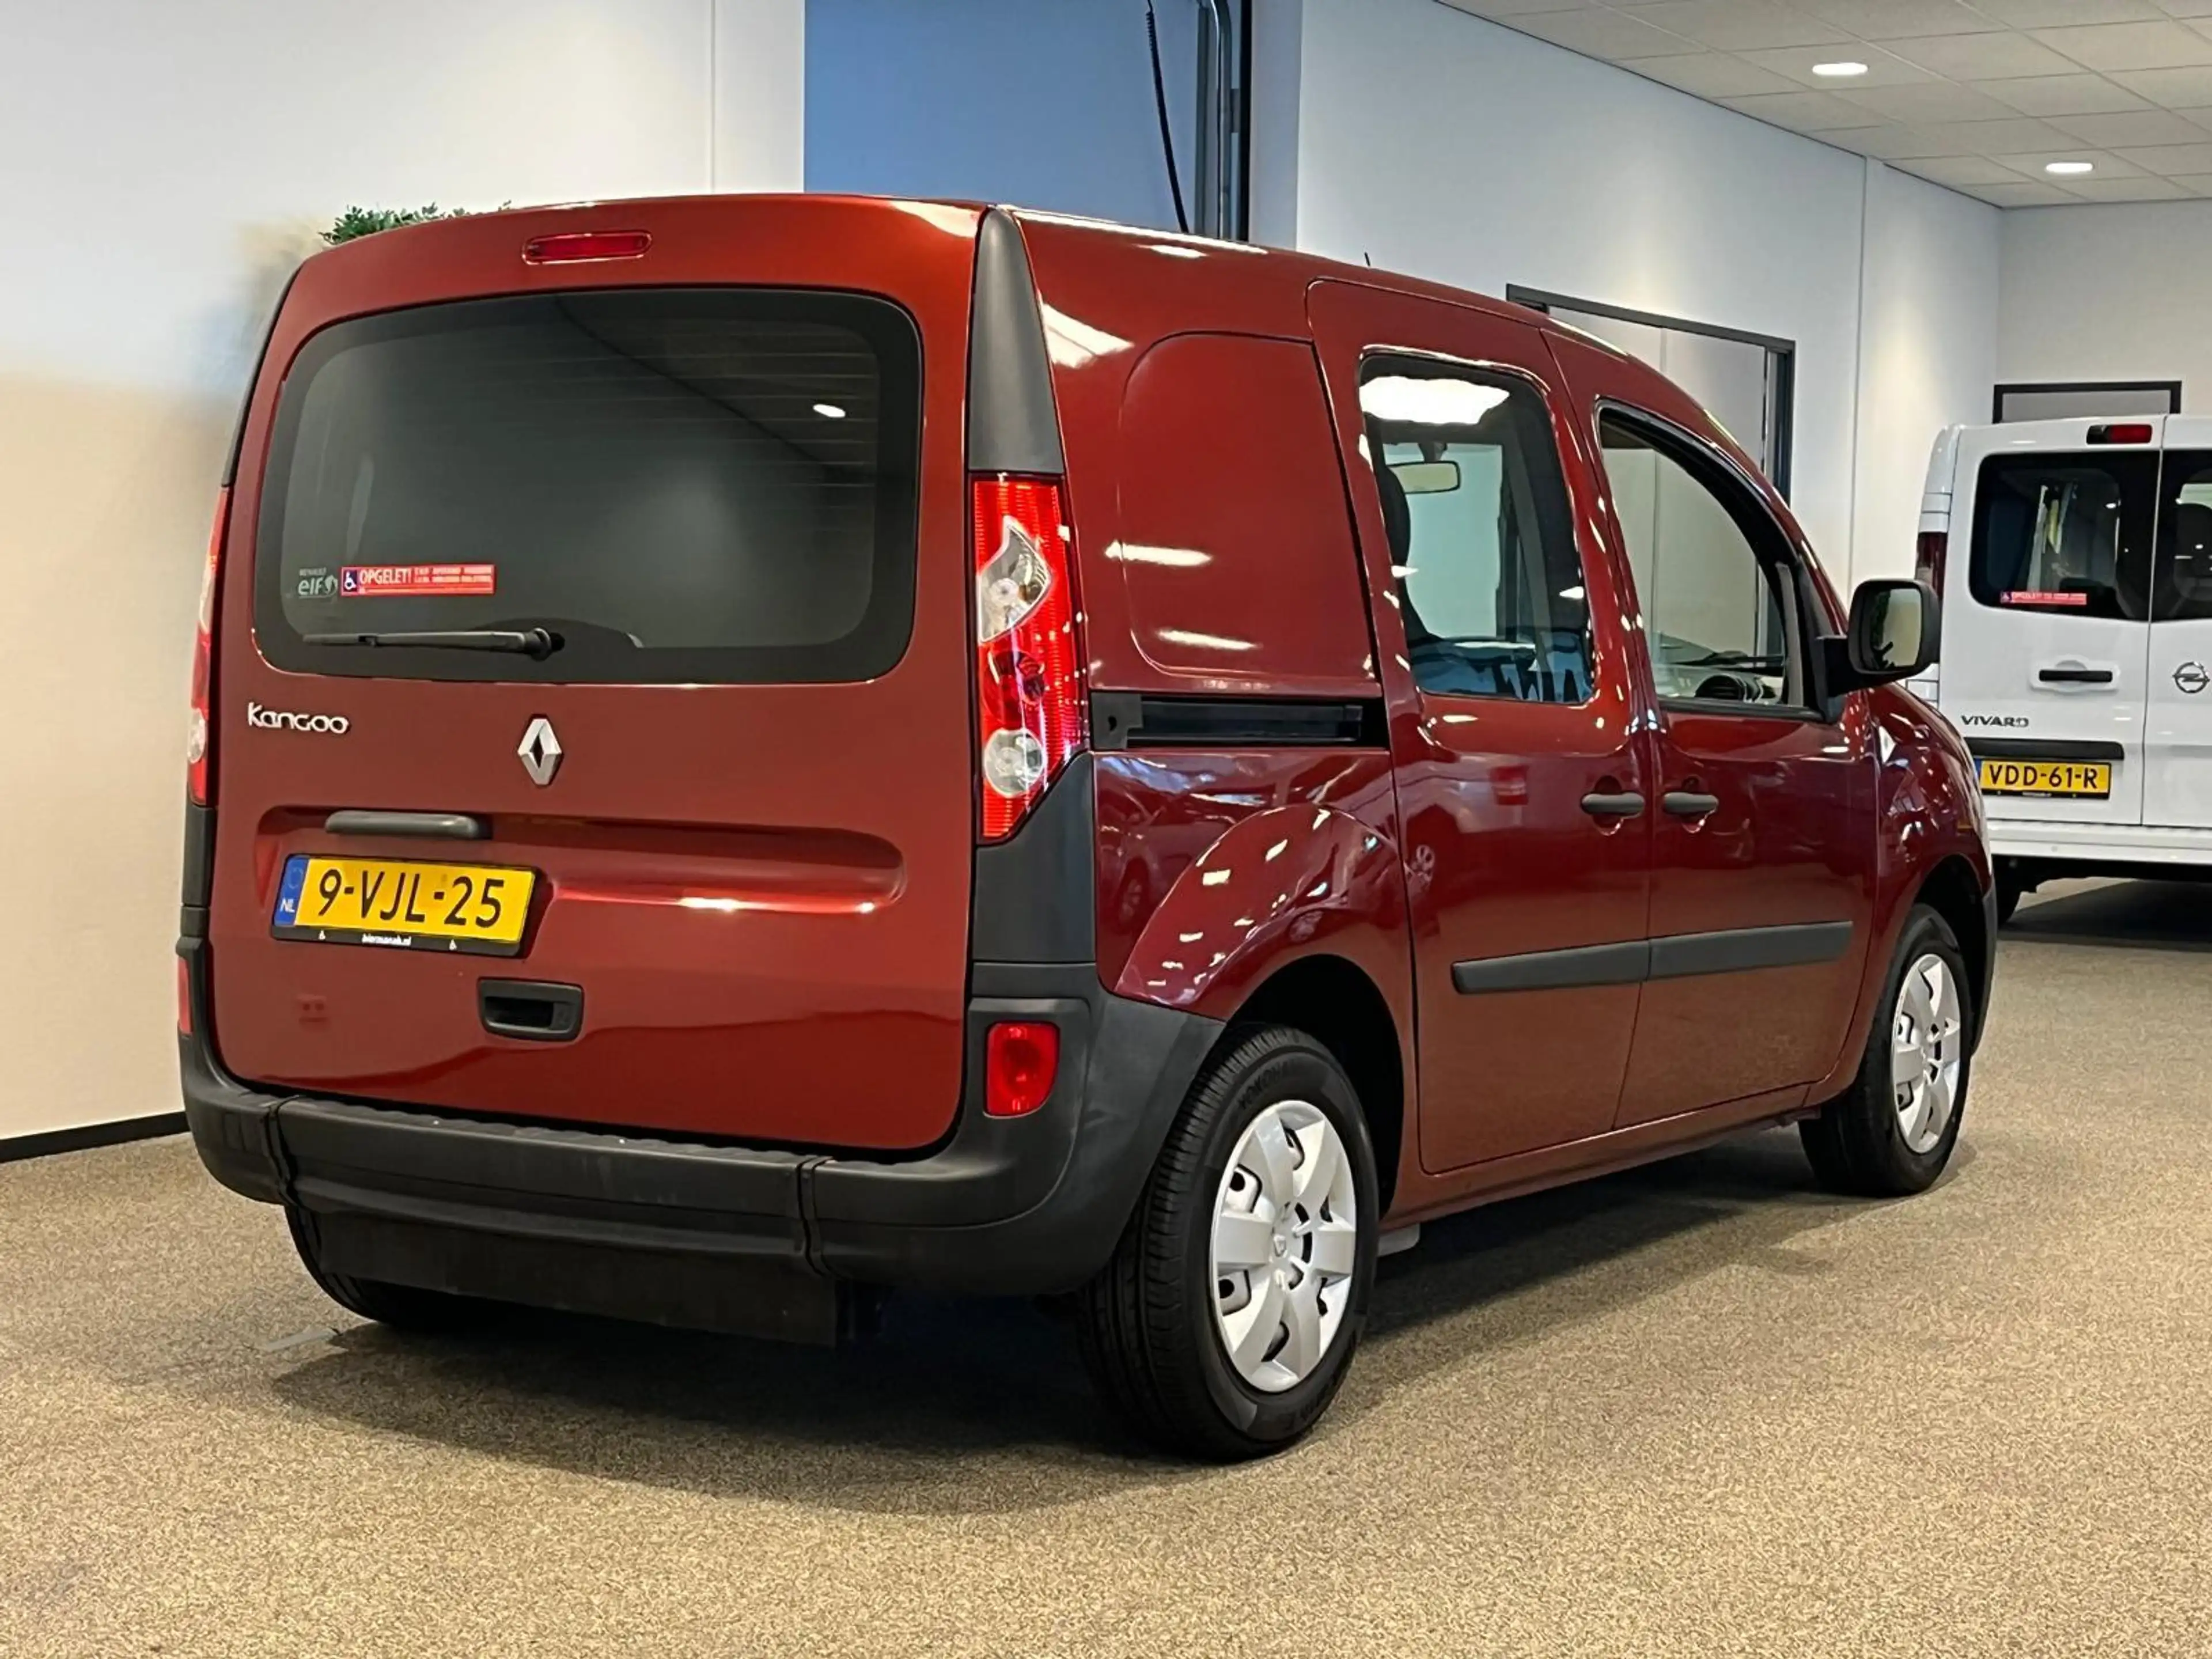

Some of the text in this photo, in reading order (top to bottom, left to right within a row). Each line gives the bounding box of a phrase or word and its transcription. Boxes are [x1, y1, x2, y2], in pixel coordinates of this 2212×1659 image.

[298, 577, 323, 595] elf
[248, 702, 349, 734] Kangoo
[1961, 715, 2029, 728] VIVARO
[1989, 764, 2097, 789] VDD-61-R
[280, 898, 295, 912] NL
[318, 869, 505, 928] 9-VJL-25
